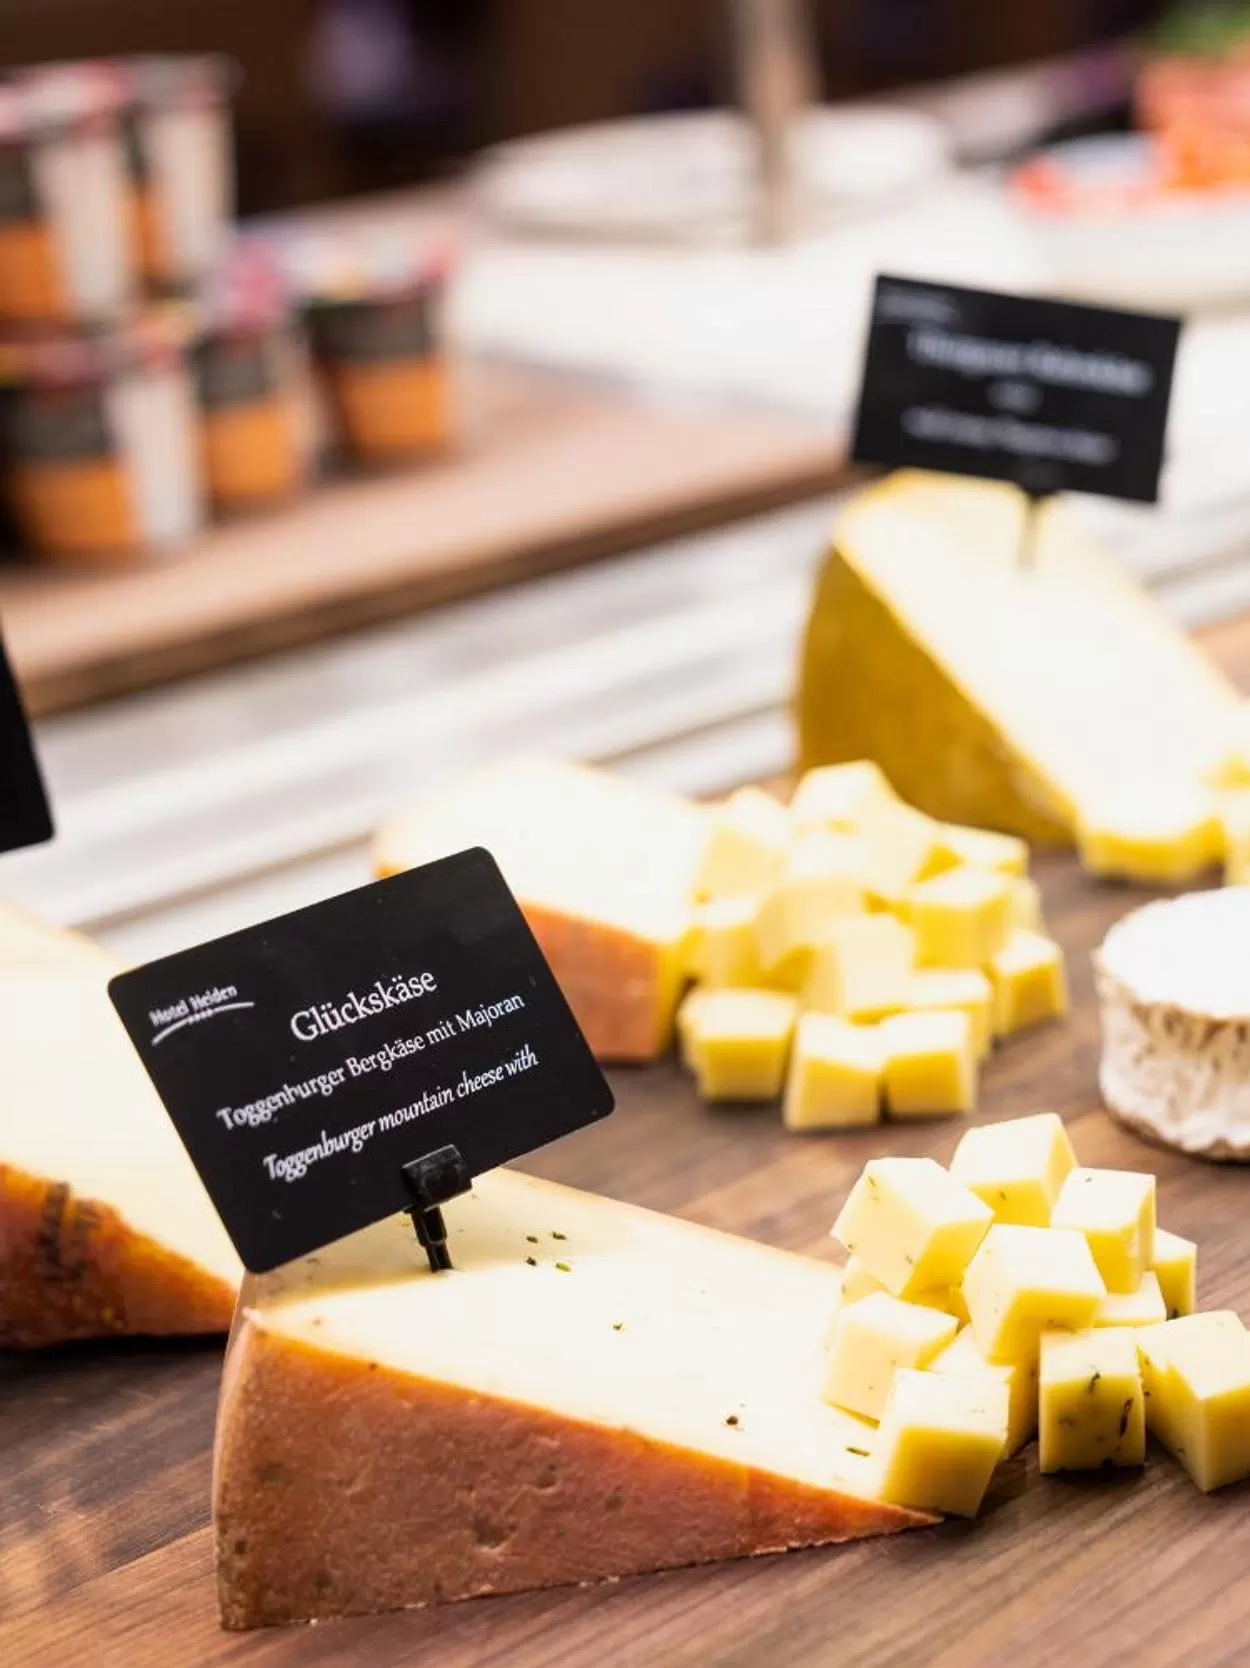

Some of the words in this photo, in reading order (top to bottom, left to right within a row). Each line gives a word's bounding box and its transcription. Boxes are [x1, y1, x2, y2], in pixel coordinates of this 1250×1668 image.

[149, 1000, 189, 1026] Hotel
[188, 986, 237, 1011] Heiden
[290, 971, 438, 1041] Glückskäse
[216, 1066, 346, 1130] Toggenburger
[346, 1035, 426, 1072] Bergkäse
[426, 1020, 457, 1045] mit
[455, 994, 526, 1033] Majoran
[263, 1121, 376, 1182] Toggenburger
[378, 1086, 455, 1132] mountain
[456, 1070, 504, 1098] cheese
[504, 1043, 540, 1077] with
